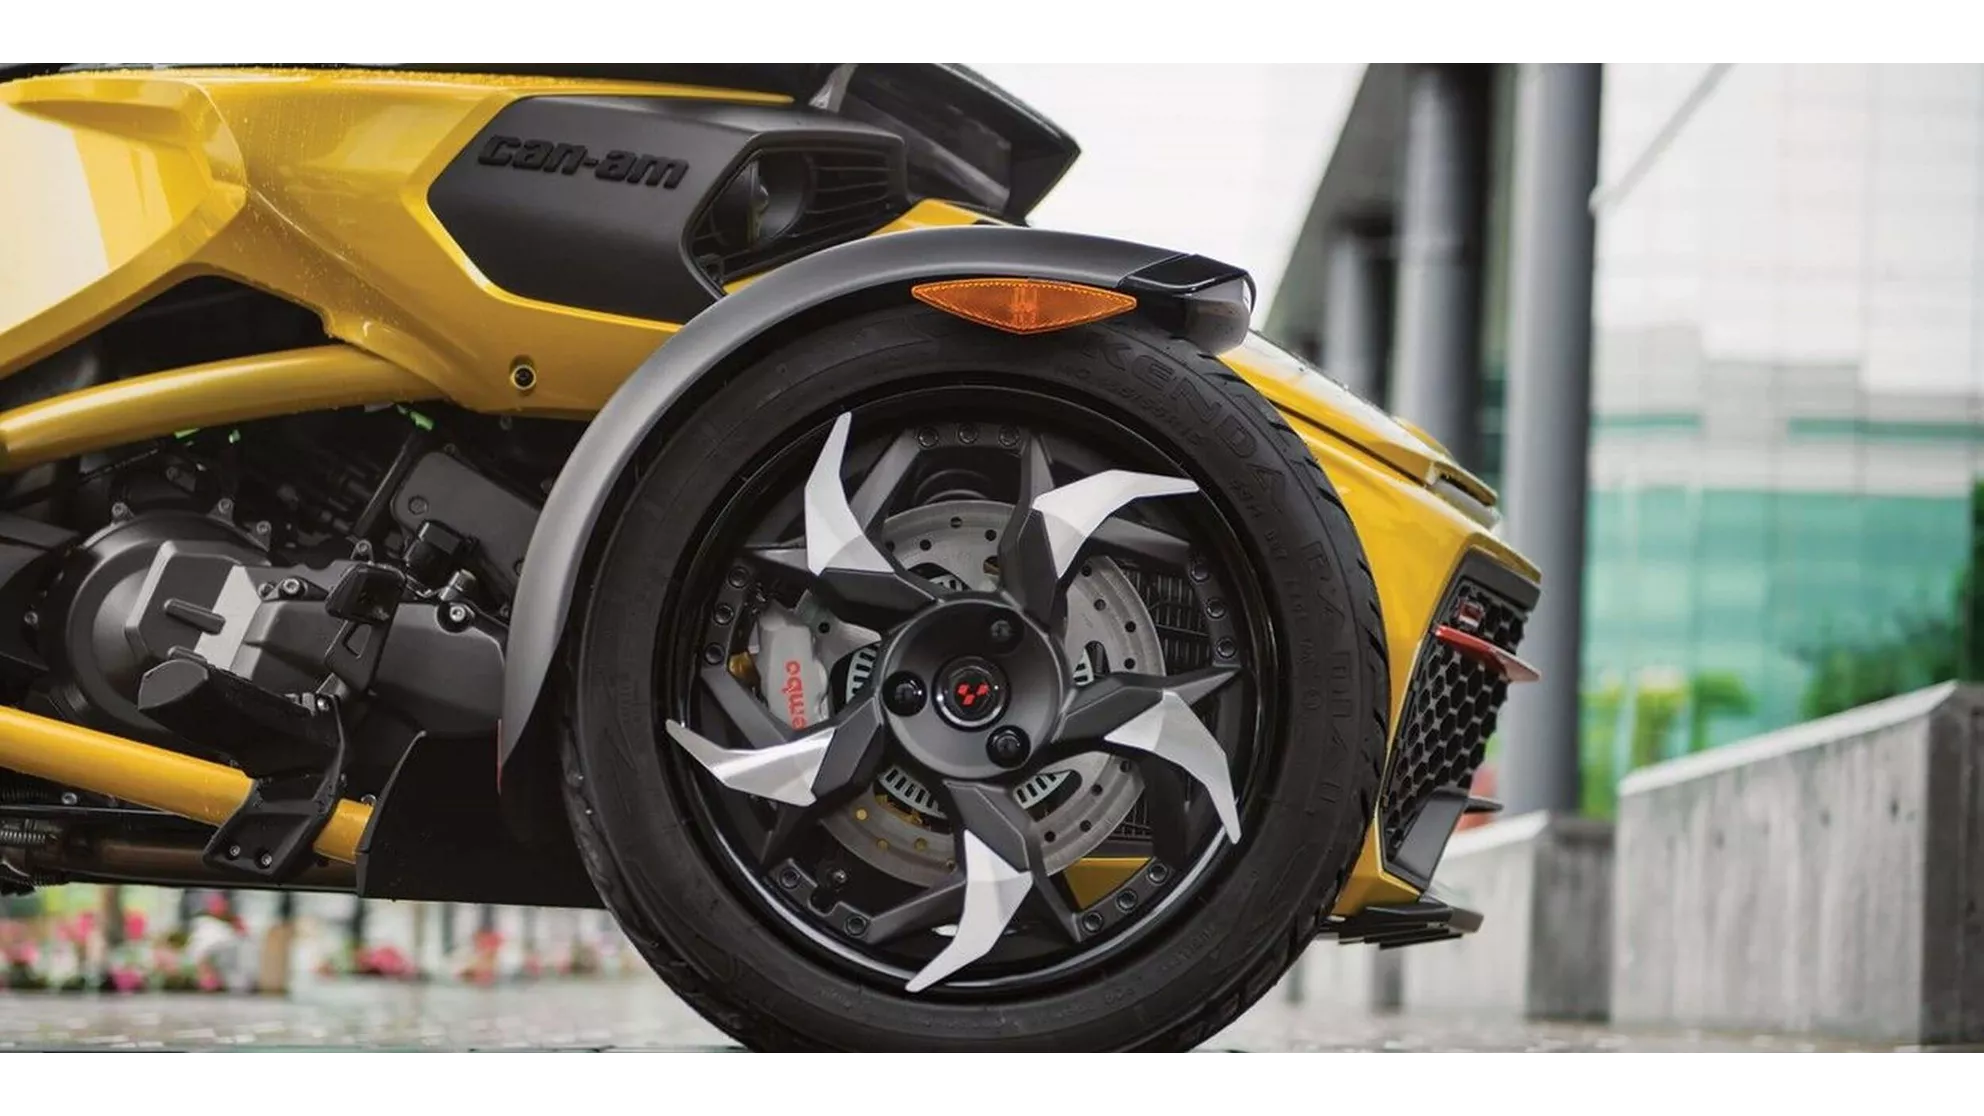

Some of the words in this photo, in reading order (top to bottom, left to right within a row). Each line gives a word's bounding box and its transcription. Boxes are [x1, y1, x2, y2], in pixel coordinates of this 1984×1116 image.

[477, 134, 690, 190] can-am
[1081, 332, 1285, 514] KENDA
[781, 660, 807, 732] embo
